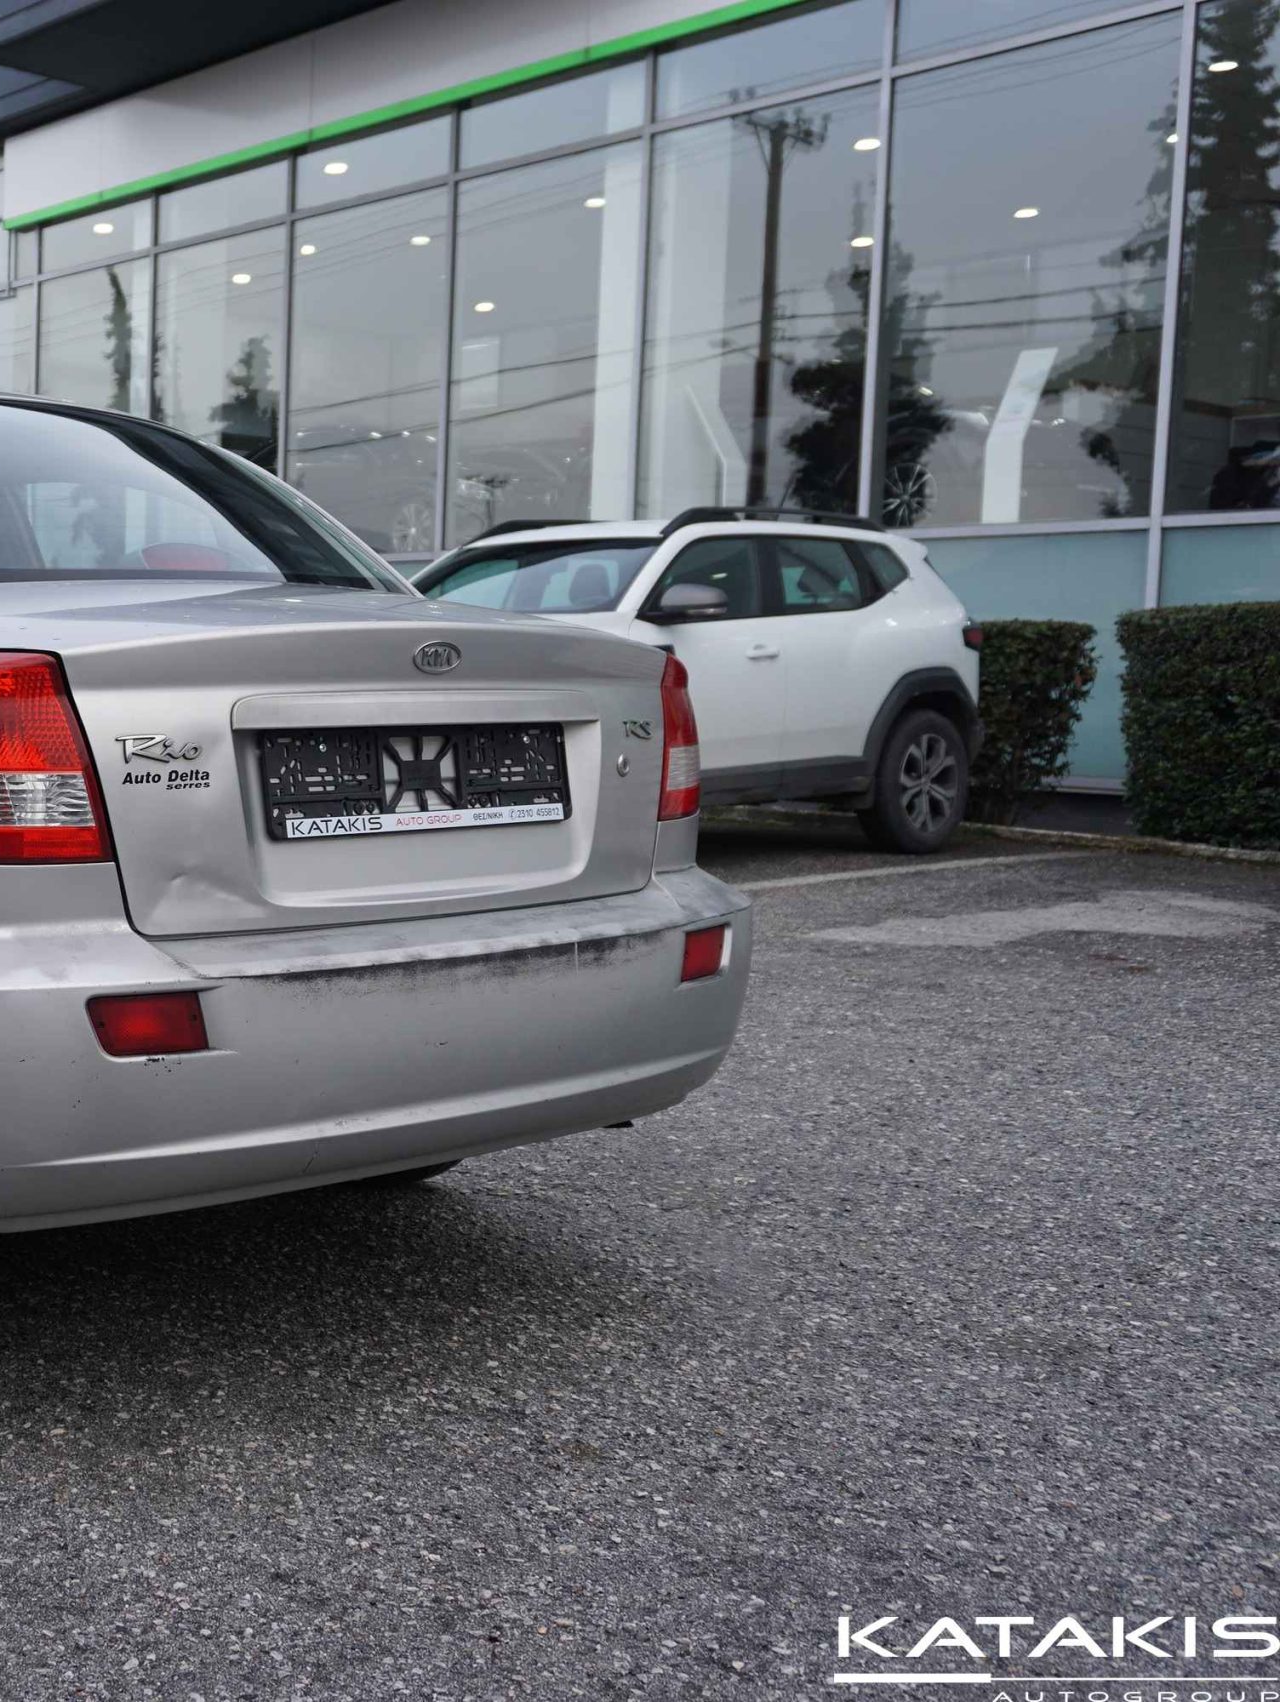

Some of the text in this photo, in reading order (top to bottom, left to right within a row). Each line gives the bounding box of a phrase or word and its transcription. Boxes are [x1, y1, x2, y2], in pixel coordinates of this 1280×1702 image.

[115, 734, 202, 764] Rio
[122, 769, 210, 785] Auto Delta
[166, 782, 211, 790] serres
[291, 816, 383, 836] KATAKIS
[395, 816, 424, 827] AUTO
[426, 814, 462, 826] GROUP
[517, 808, 534, 818] 2310
